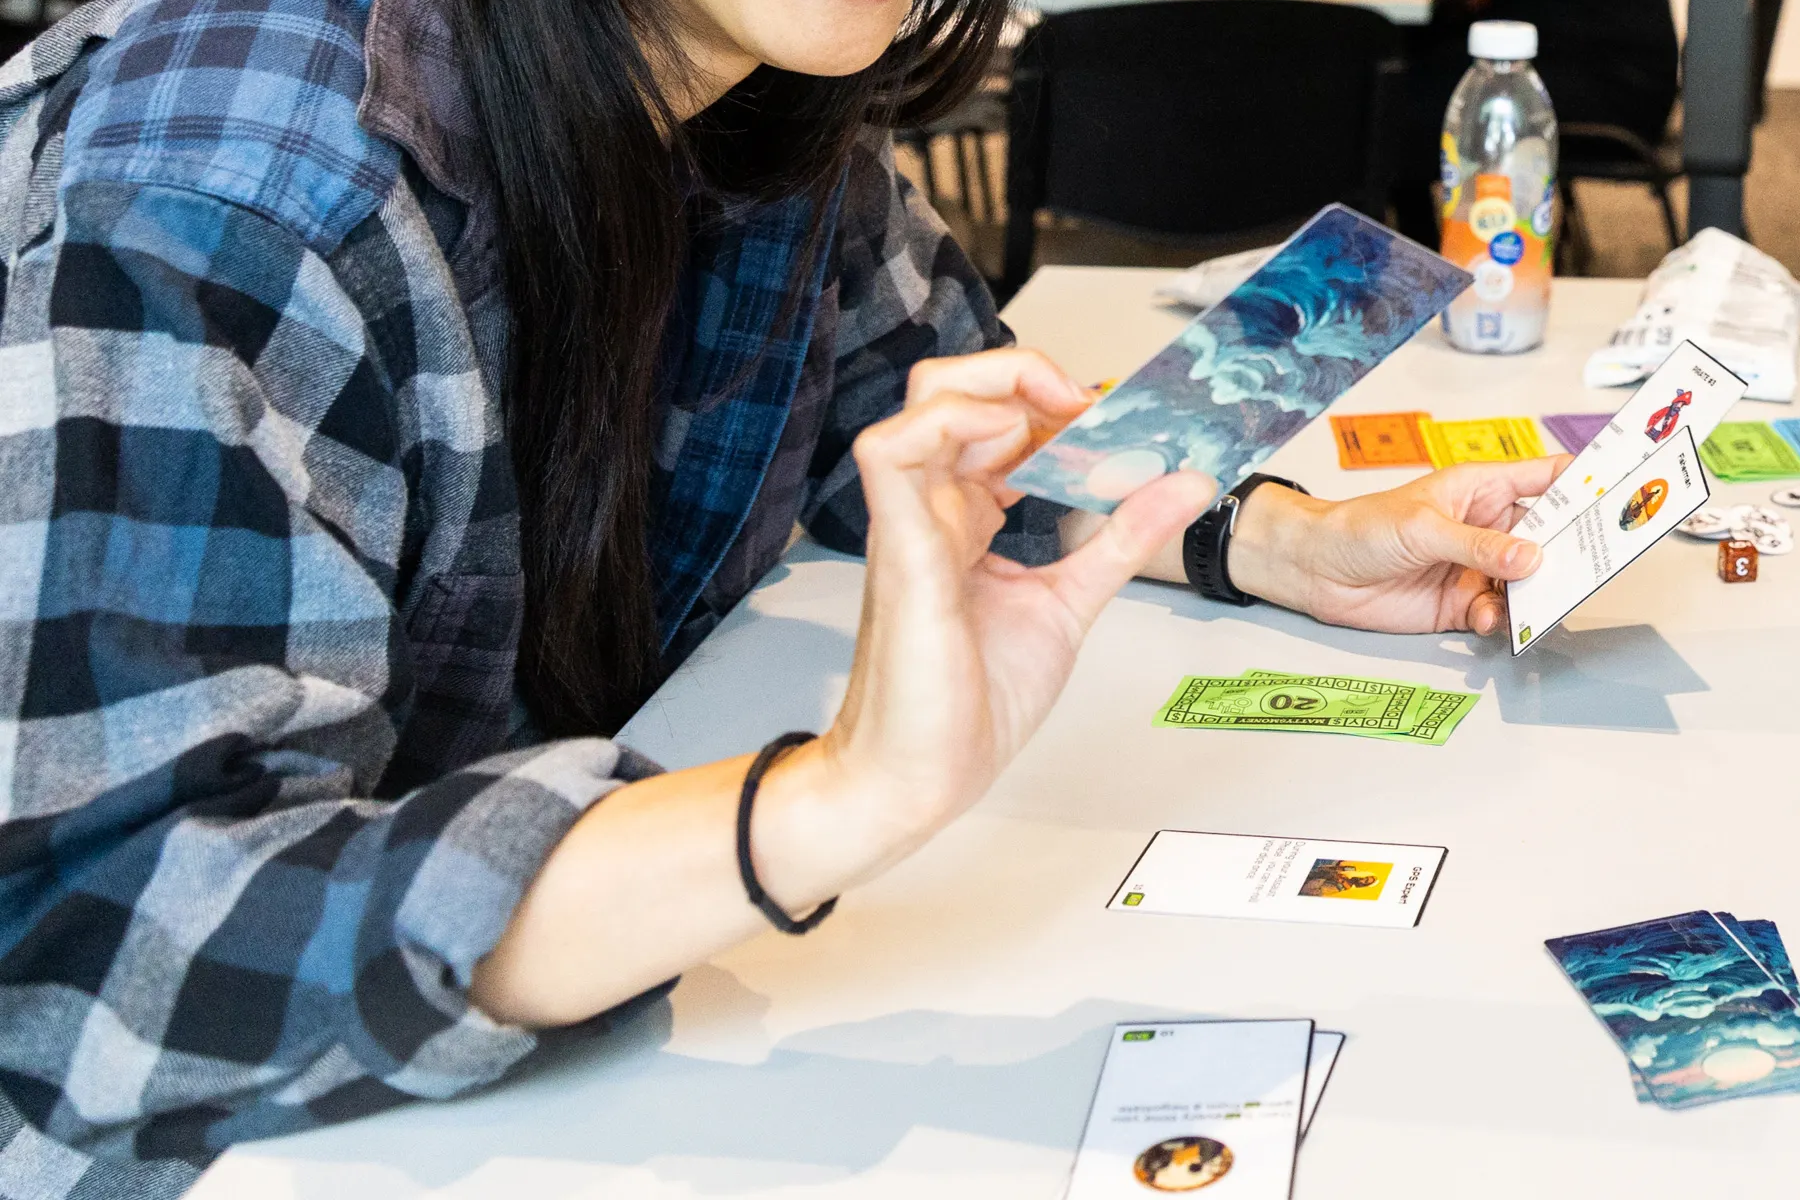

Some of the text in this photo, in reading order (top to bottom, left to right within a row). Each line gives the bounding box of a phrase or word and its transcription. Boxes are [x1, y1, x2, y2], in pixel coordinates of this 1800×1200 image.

[1692, 365, 1710, 382] PIRATE
[1679, 452, 1691, 488] Fisherman
[1735, 557, 1749, 576] 3
[1269, 695, 1319, 711] 20
[1285, 841, 1306, 860] During
[1280, 860, 1292, 874] your
[1400, 866, 1422, 905] GPS Expert
